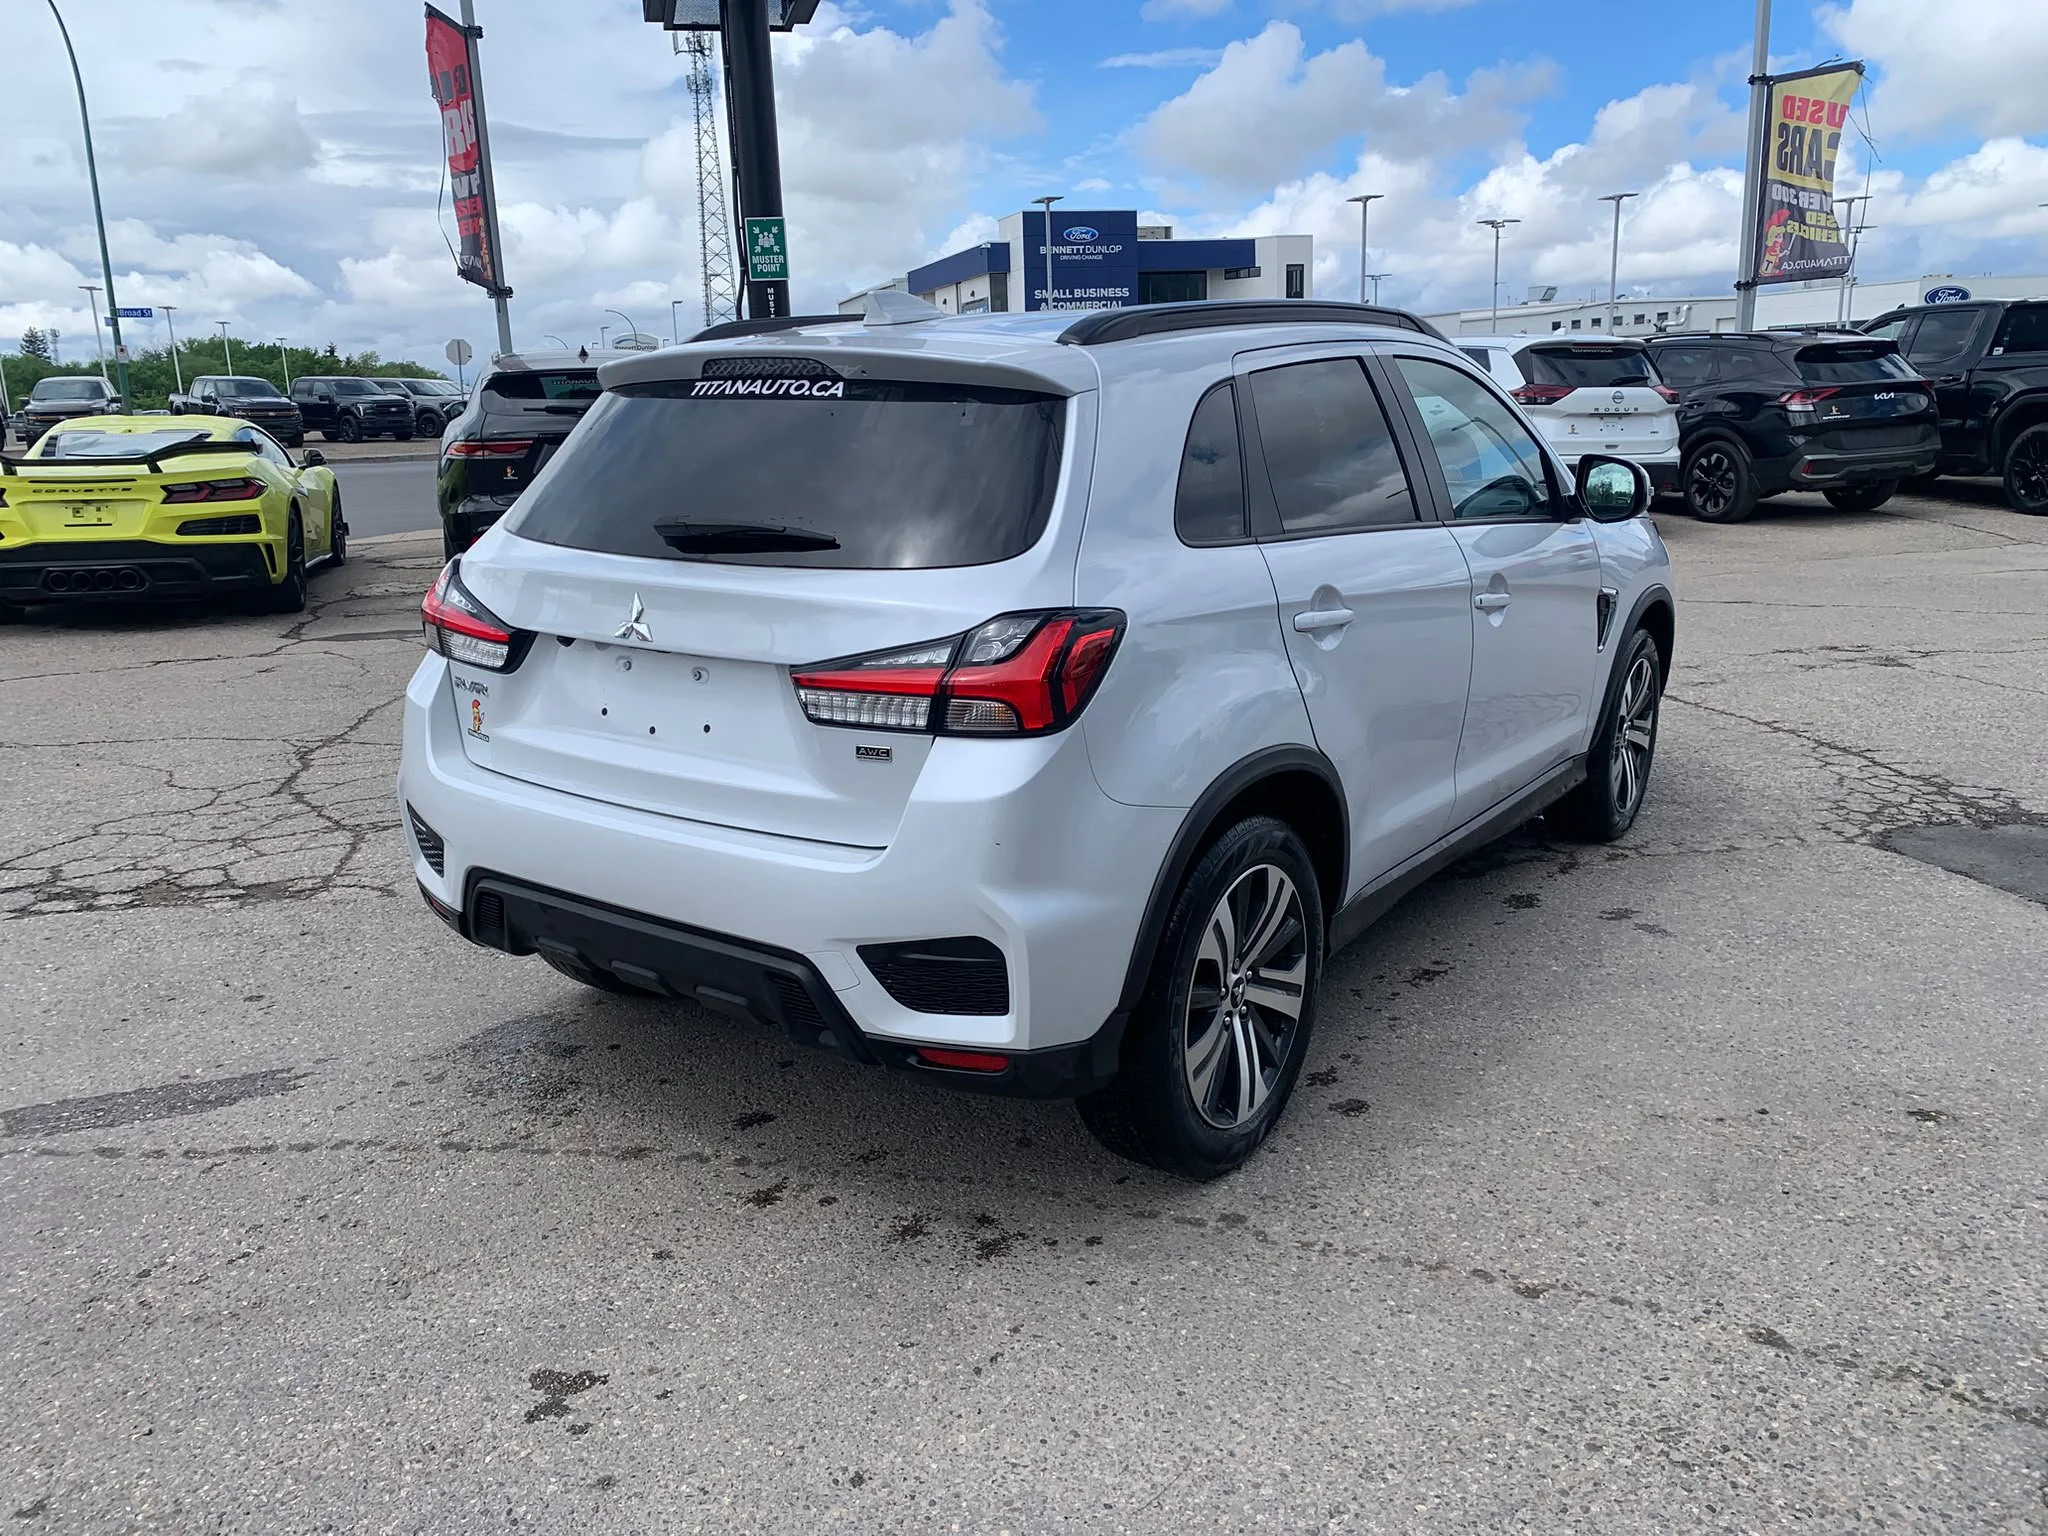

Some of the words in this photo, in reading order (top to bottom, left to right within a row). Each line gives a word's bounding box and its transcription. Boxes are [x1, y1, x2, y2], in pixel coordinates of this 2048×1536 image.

[1086, 245, 1122, 254] DUNLOP
[752, 255, 784, 264] MUSTER
[757, 264, 781, 272] POINT
[1074, 288, 1130, 298] BUSINESS
[690, 380, 844, 398] TITANAUTO.CA
[858, 747, 888, 757] AWC
